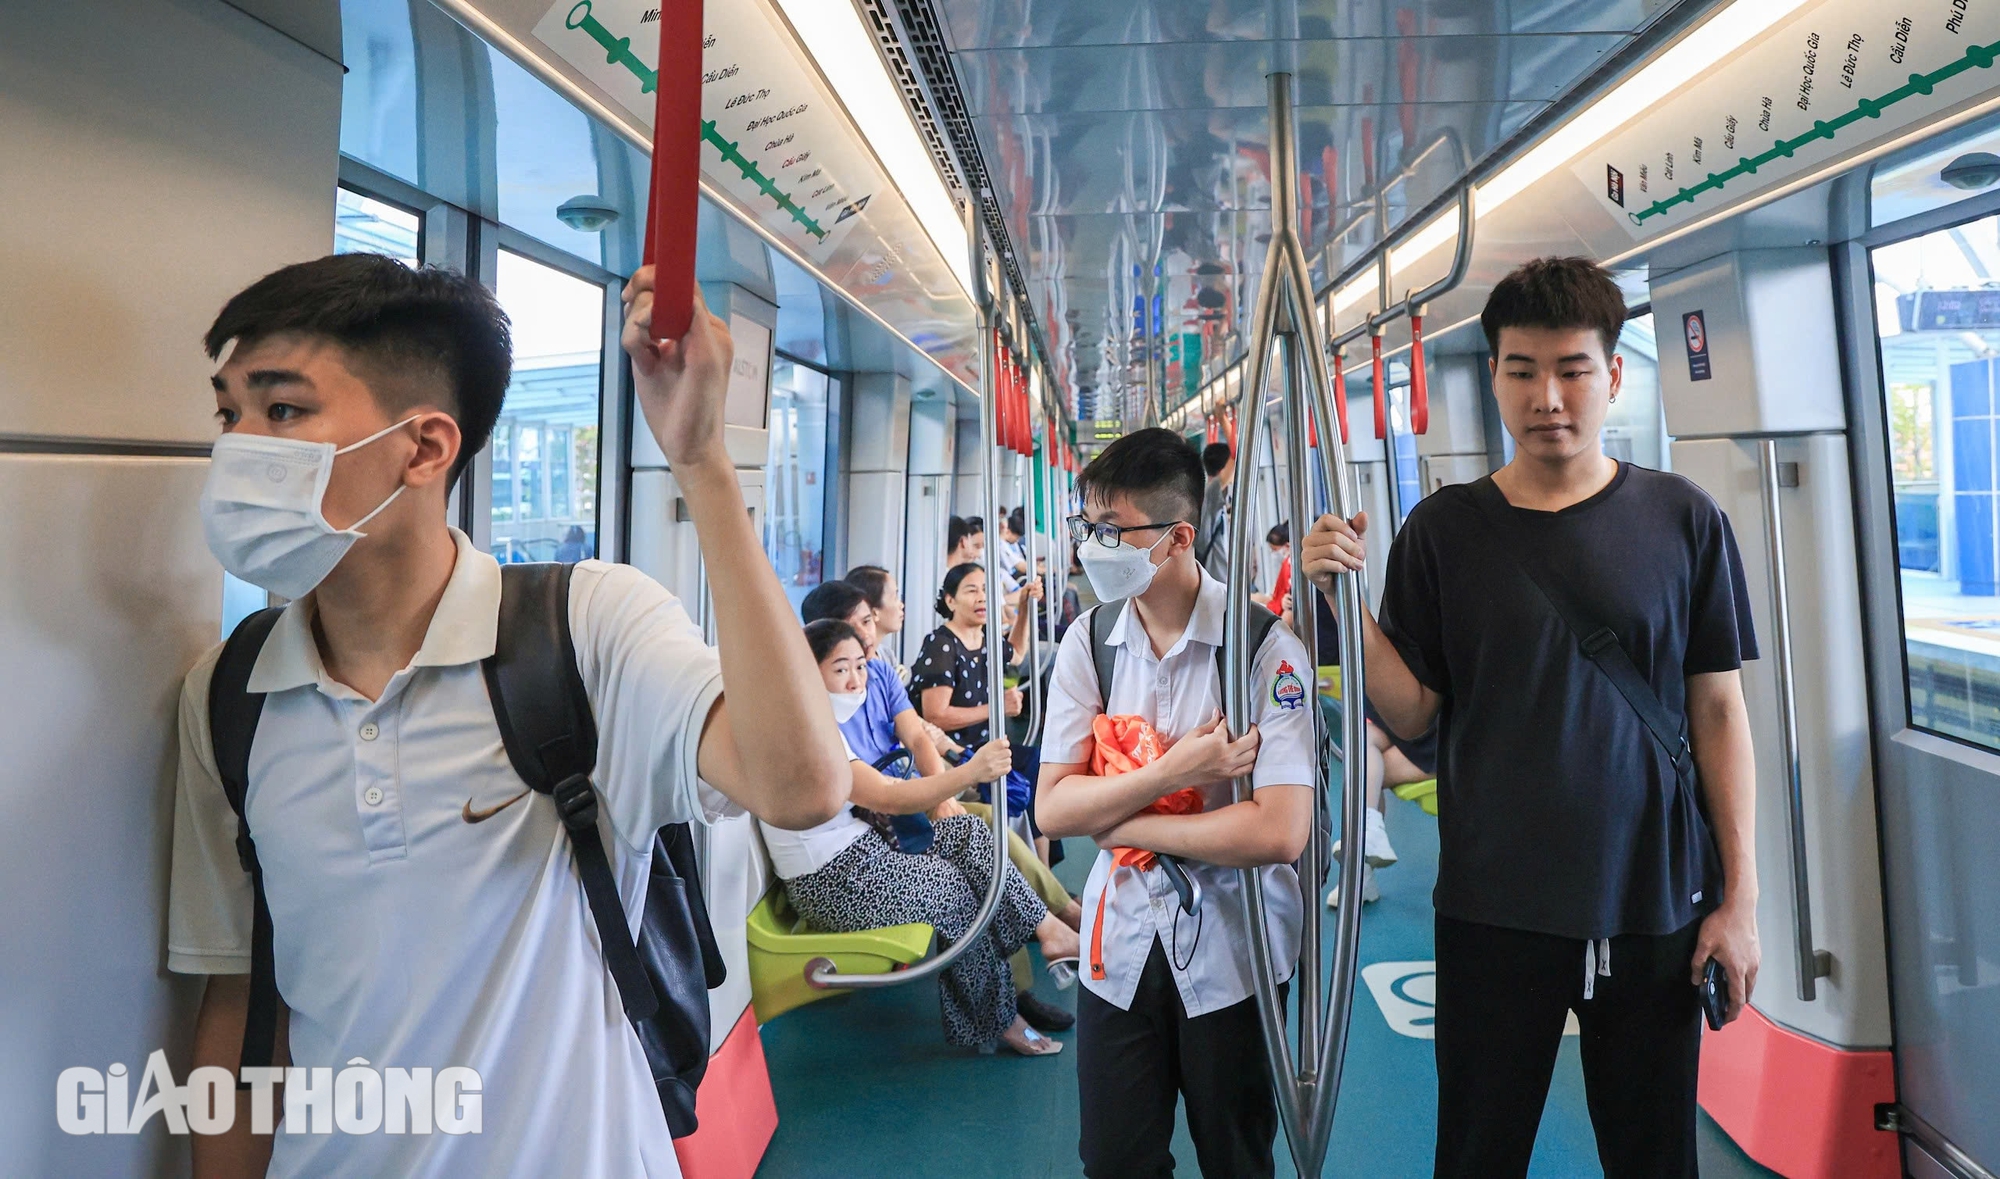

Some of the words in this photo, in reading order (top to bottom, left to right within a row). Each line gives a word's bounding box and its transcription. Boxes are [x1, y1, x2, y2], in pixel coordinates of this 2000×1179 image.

[640, 8, 662, 24] Min
[1945, 9, 1964, 34] Phú
[1895, 17, 1912, 43] Diễn
[702, 33, 716, 49] iễn
[1807, 32, 1820, 50] Gia
[1847, 33, 1865, 52] Thọ
[1803, 50, 1817, 75] Quốc
[1889, 42, 1906, 64] Cầu
[701, 69, 720, 85] Cầu
[719, 63, 739, 80] Diễn
[1843, 54, 1858, 75] Đức
[1799, 76, 1814, 96] Học
[1840, 74, 1853, 88] Lê
[725, 97, 738, 110] Lê
[737, 93, 755, 106] Đức
[755, 88, 771, 100] Thọ
[1761, 96, 1772, 111] Hà
[1796, 93, 1811, 111] Đại
[746, 118, 761, 131] Đại
[759, 115, 777, 127] Học
[776, 106, 796, 121] Quốc
[795, 103, 809, 115] Gia
[1758, 109, 1771, 132] Chùa
[1724, 133, 1735, 149] Cầu
[1692, 149, 1702, 165] Kim
